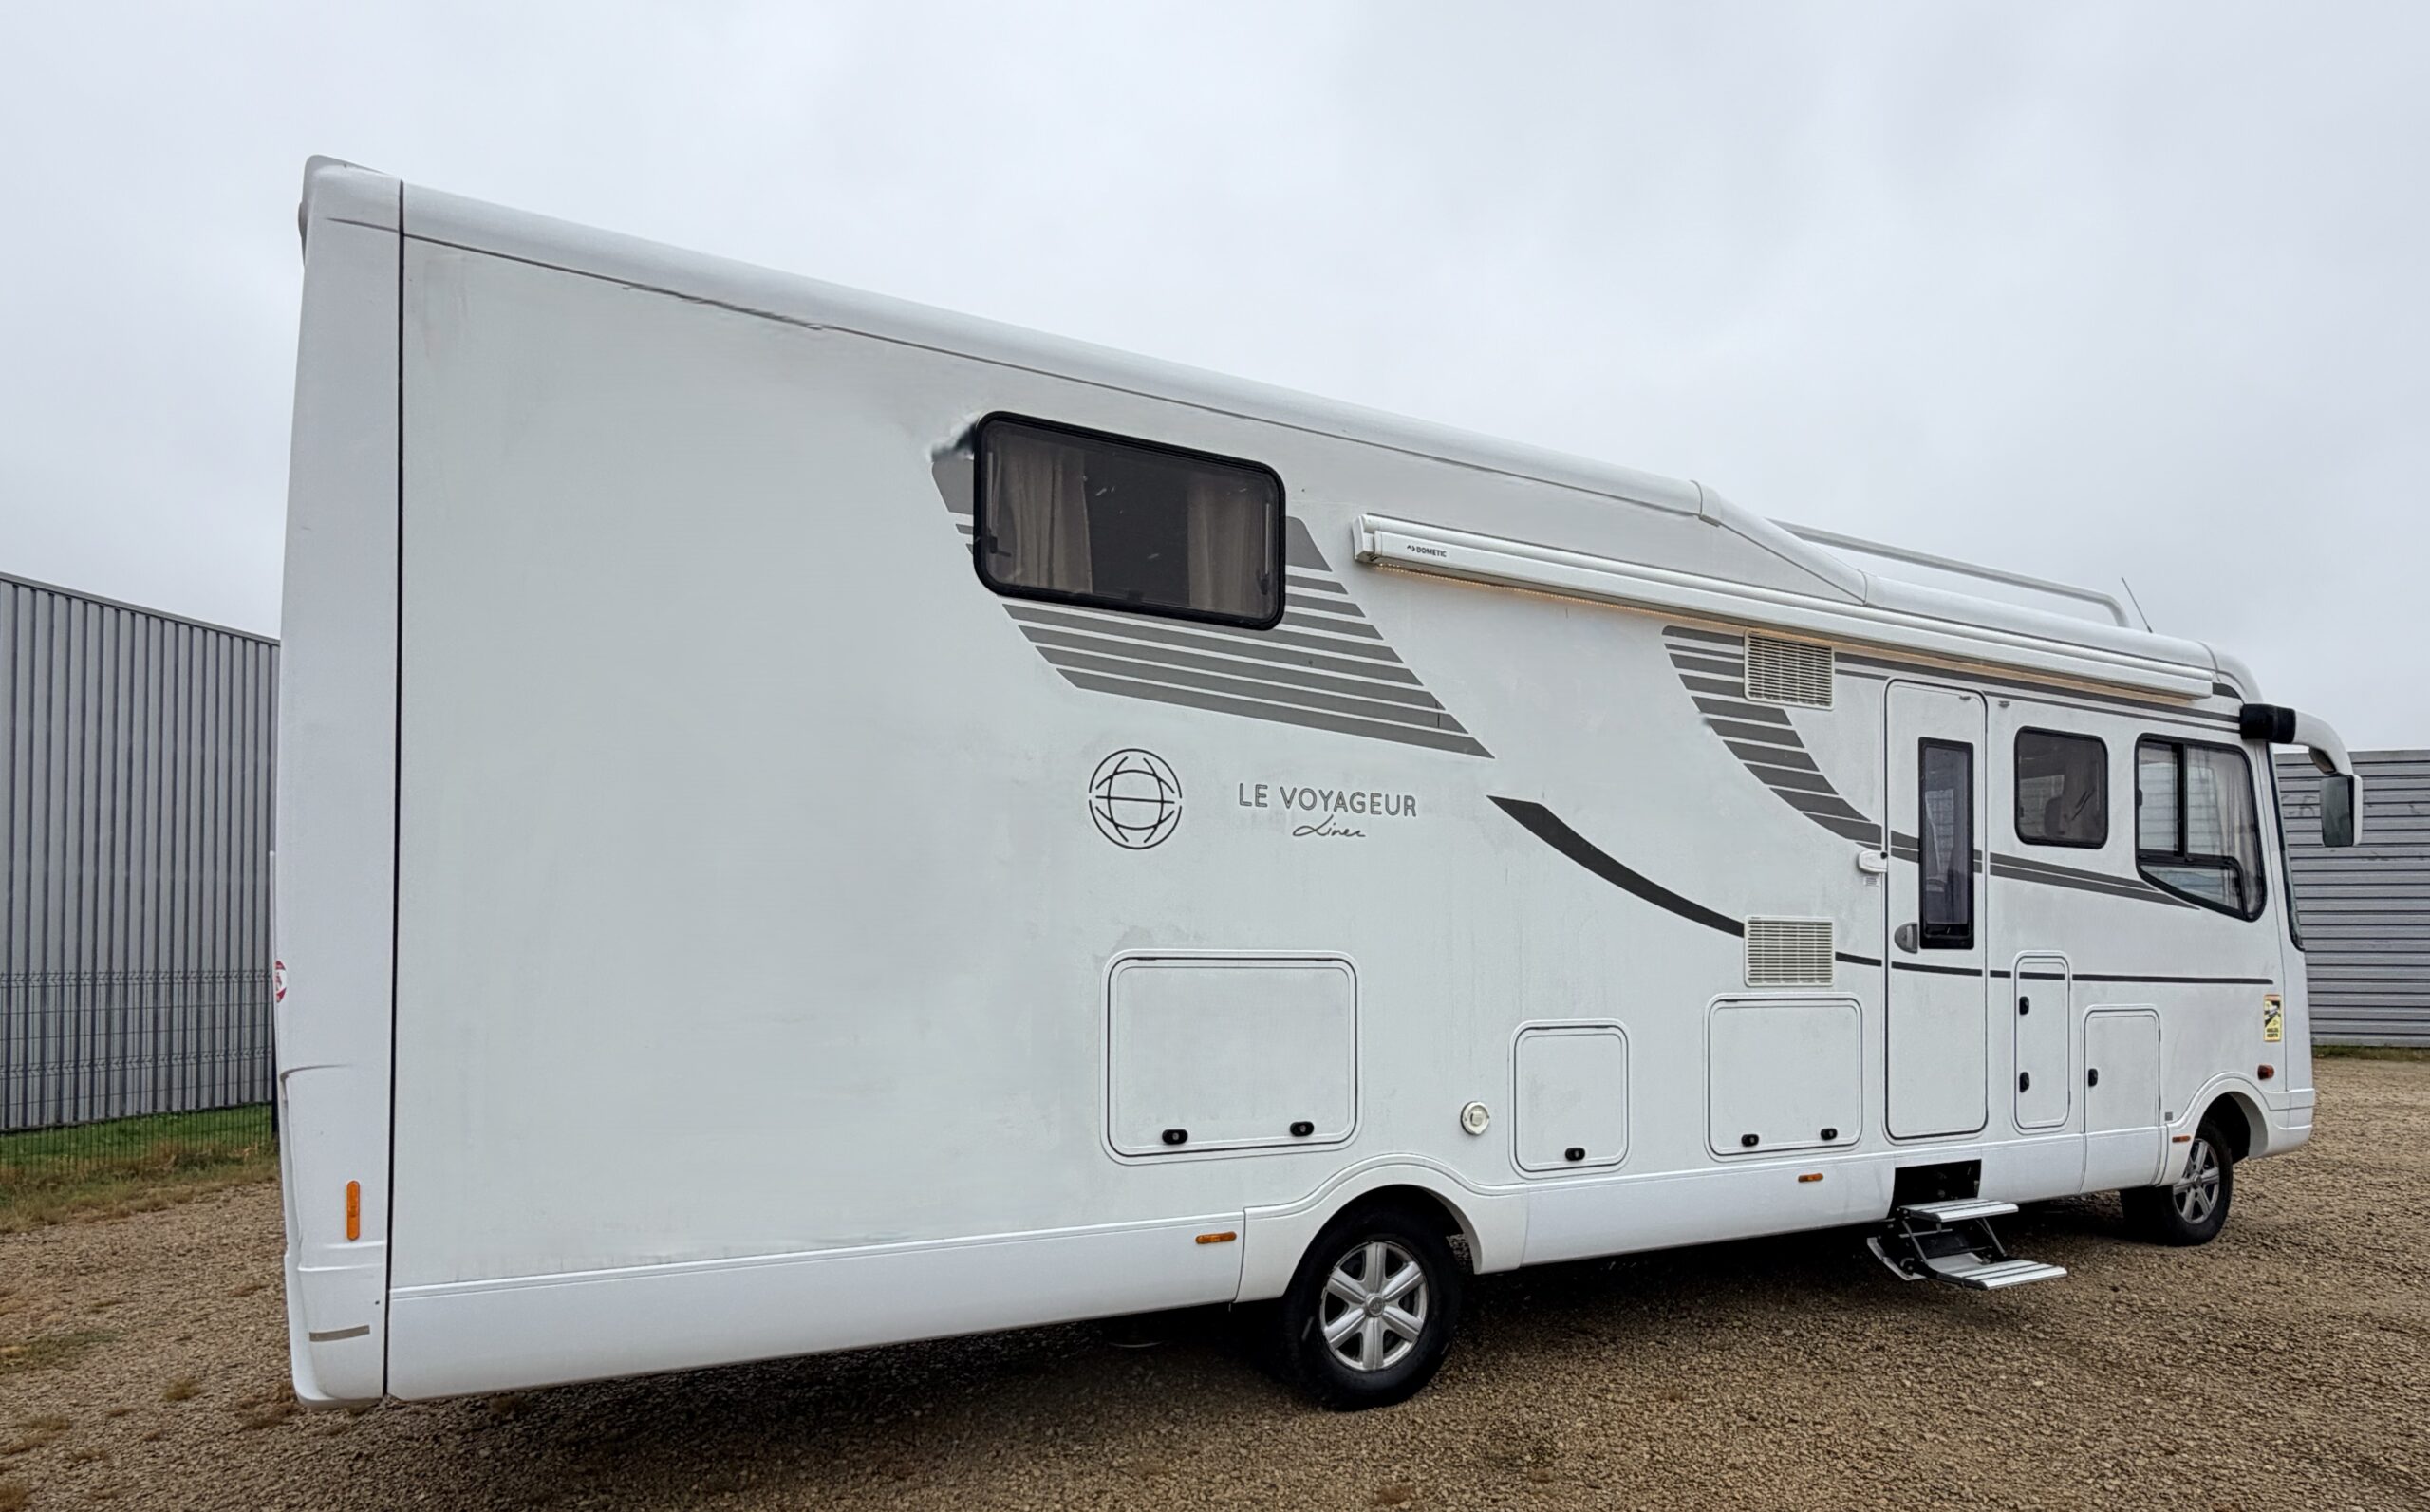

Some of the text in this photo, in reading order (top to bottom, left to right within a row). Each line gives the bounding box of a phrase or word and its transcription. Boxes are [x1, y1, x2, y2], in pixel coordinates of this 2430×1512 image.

[1416, 546, 1448, 558] DOMETIC
[1239, 782, 1417, 817] LE VOYAGEUR
